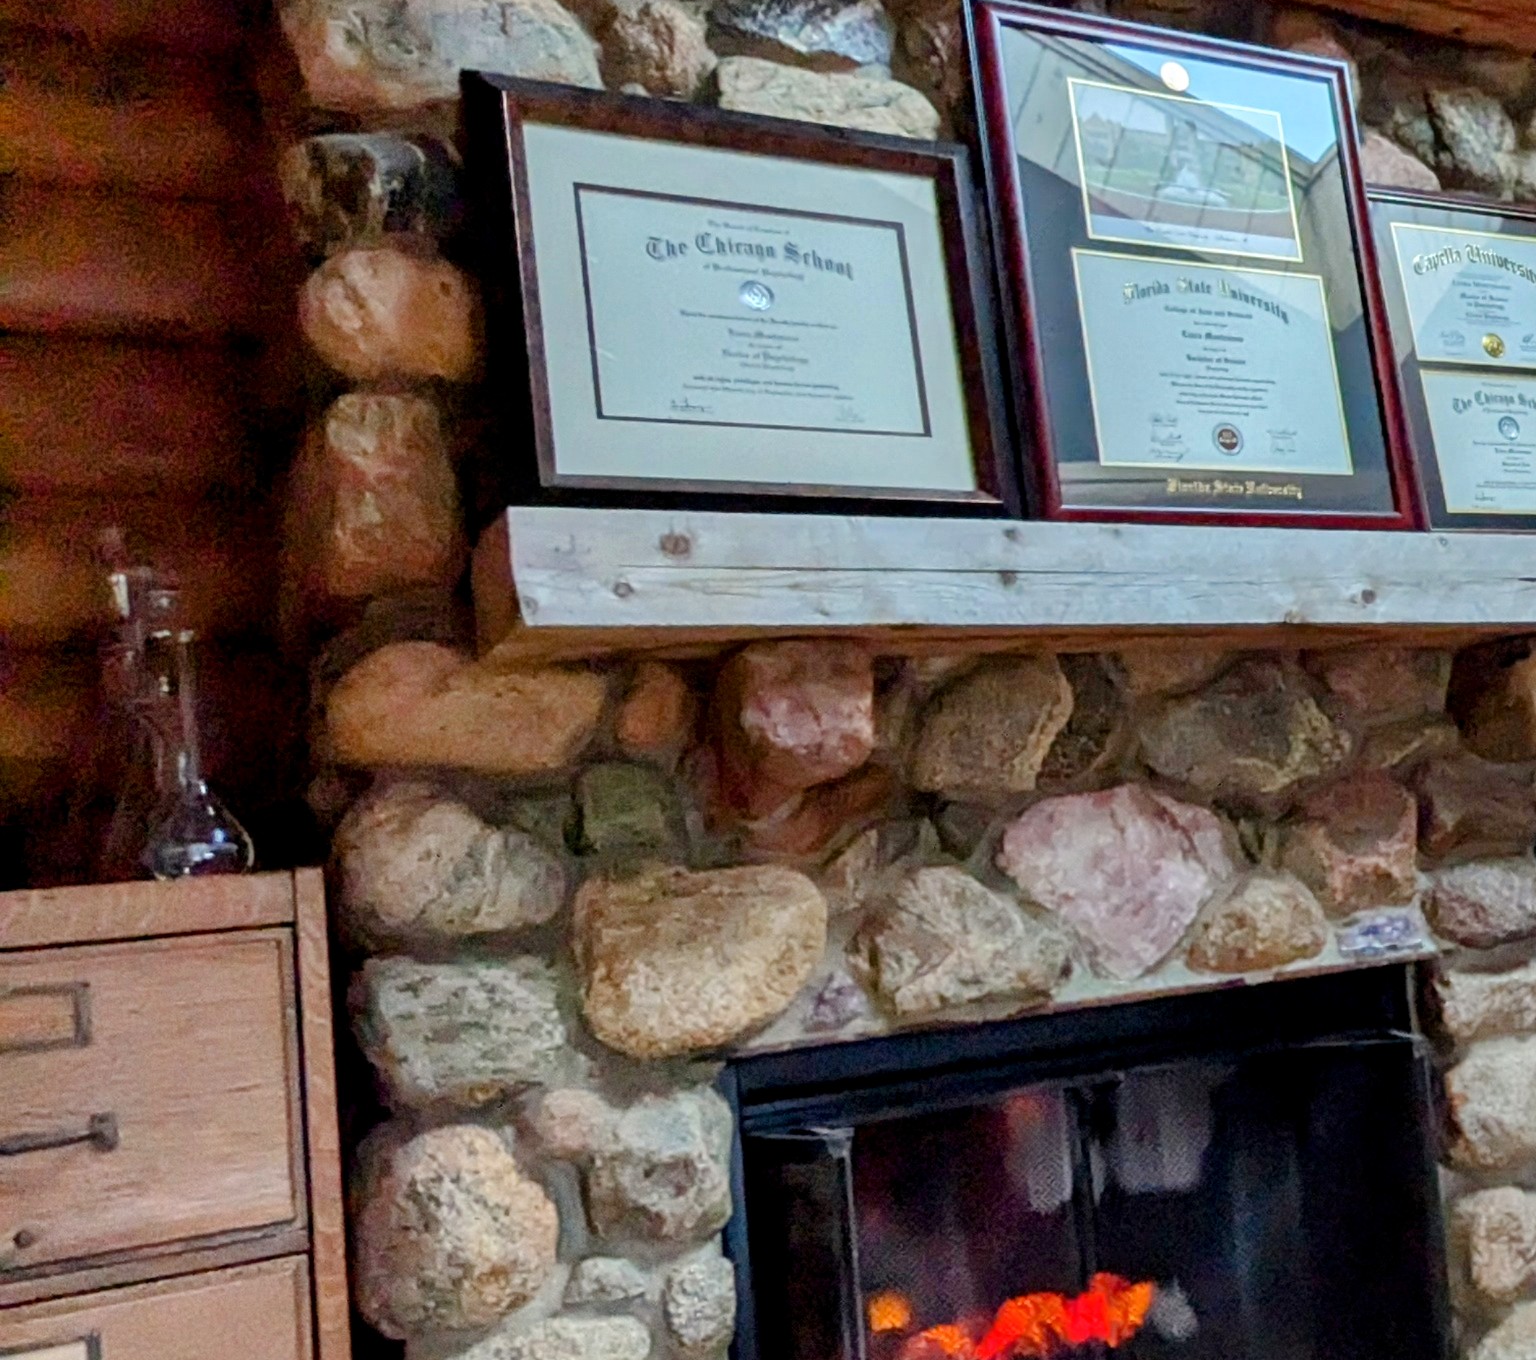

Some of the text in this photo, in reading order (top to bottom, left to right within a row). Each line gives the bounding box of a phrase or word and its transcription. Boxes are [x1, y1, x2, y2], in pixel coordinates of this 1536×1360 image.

[646, 236, 688, 261] The
[695, 232, 776, 262] Chicago
[783, 241, 854, 281] School
[1413, 245, 1462, 276] Capella
[1123, 280, 1170, 305] Florida
[1176, 276, 1212, 295] State
[1217, 278, 1289, 324] University
[1452, 397, 1472, 414] The
